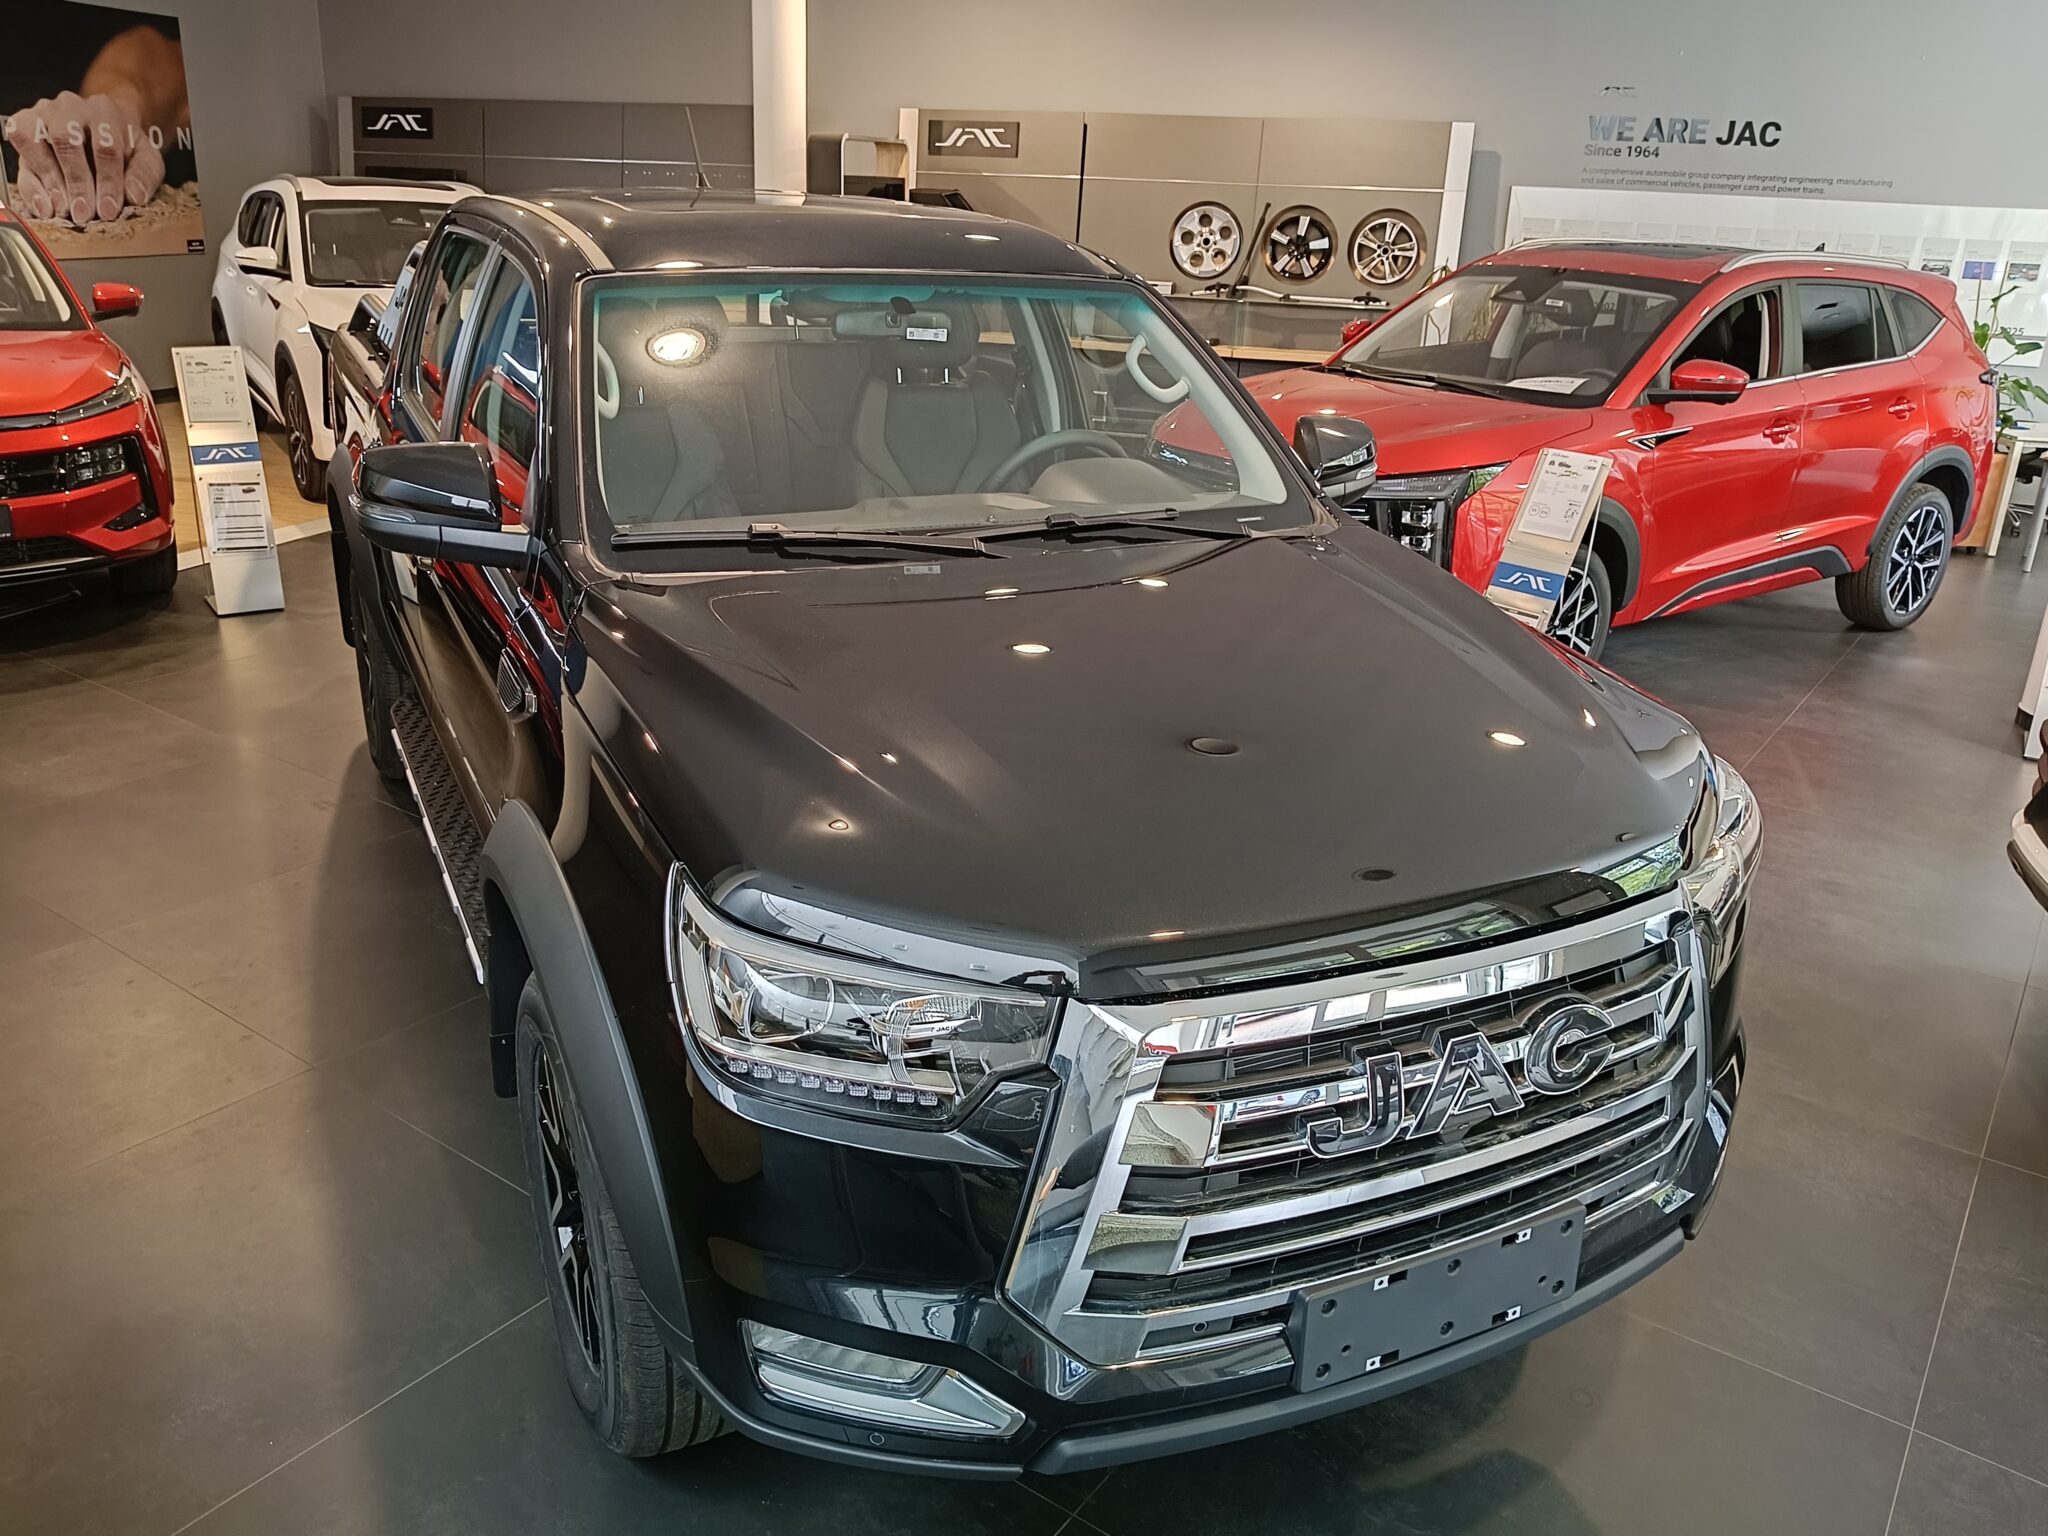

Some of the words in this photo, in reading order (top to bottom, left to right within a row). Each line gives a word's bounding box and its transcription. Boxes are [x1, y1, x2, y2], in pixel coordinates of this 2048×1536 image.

[4, 116, 193, 151] PASSION
[1588, 115, 1638, 142] WE
[1641, 117, 1710, 145] ARE
[1715, 120, 1783, 148] JAC
[1583, 144, 1622, 157] Since
[1626, 145, 1660, 158] 1964
[1580, 176, 1595, 184] and
[1596, 177, 1615, 185] sales
[1616, 177, 1625, 186] of
[1625, 178, 1669, 187] commercial
[1702, 181, 1742, 192] passenger
[1743, 184, 1760, 192] cars
[1761, 184, 1776, 193] and
[1777, 185, 1801, 195] power
[1589, 167, 1644, 177] comprehensive
[1645, 169, 1687, 178] automobile
[1688, 171, 1710, 180] group
[1711, 172, 1745, 182] company
[1747, 174, 1787, 184] integrating
[1836, 177, 1894, 188] manufacturing
[1304, 998, 1616, 1159] JAC
